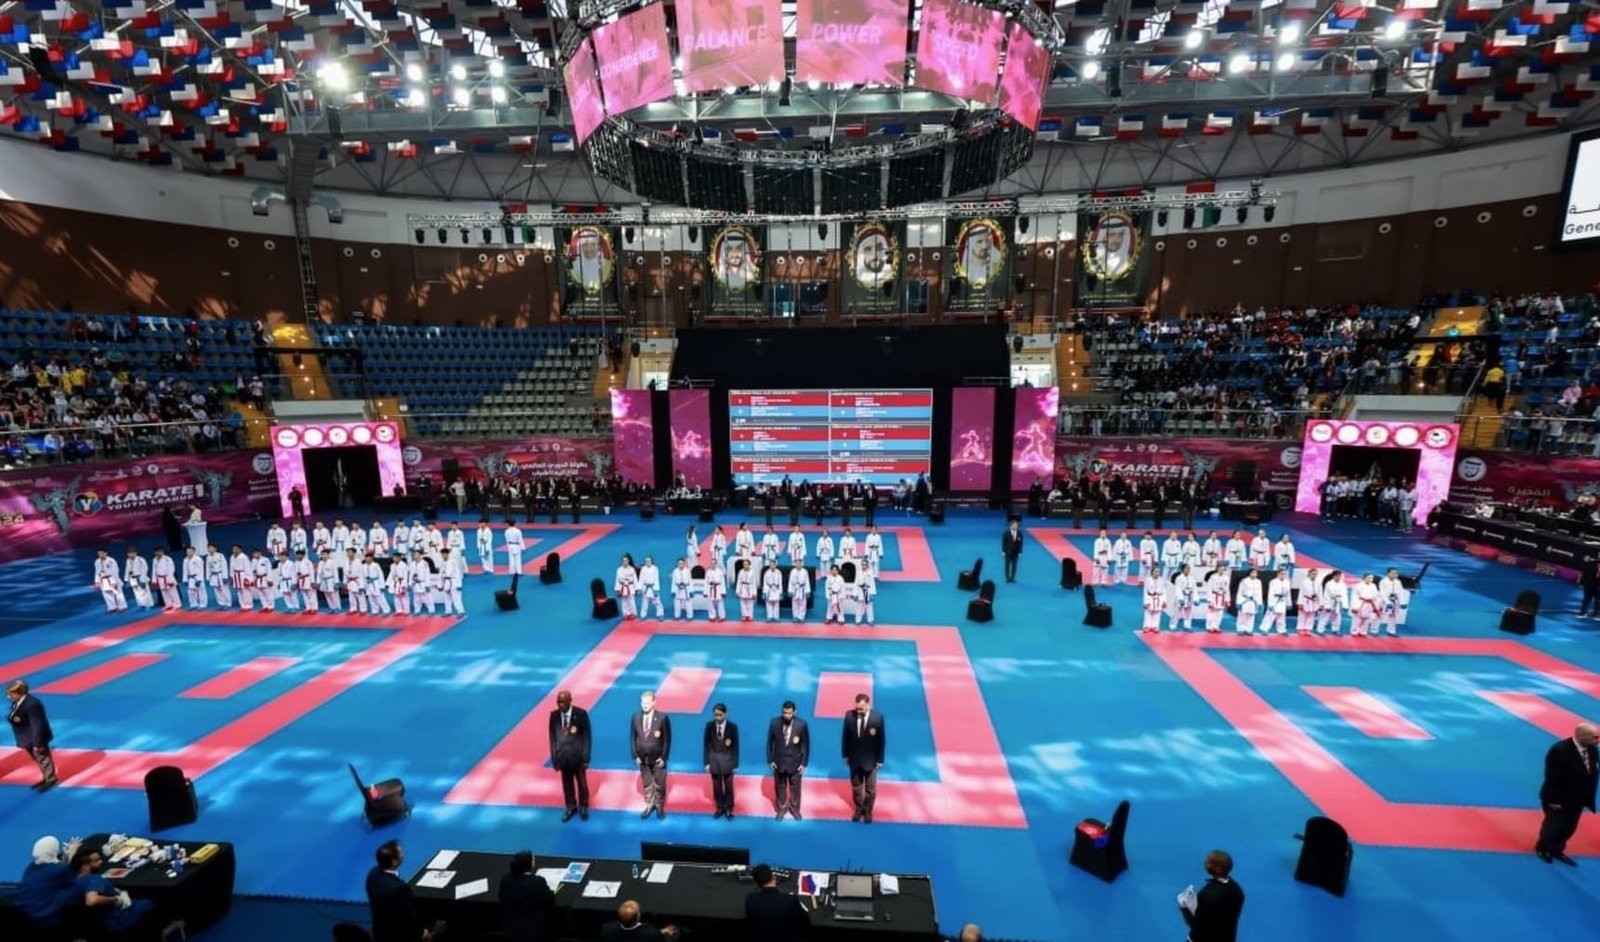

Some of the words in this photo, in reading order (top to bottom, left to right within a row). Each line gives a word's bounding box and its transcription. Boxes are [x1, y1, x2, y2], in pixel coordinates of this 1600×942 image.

[683, 24, 769, 51] BALANCE
[811, 23, 883, 45] POWER
[934, 33, 979, 60] SPEED
[600, 48, 660, 79] CONFIDENCE
[108, 501, 147, 510] YOUTH
[151, 494, 194, 504] LEAGUE
